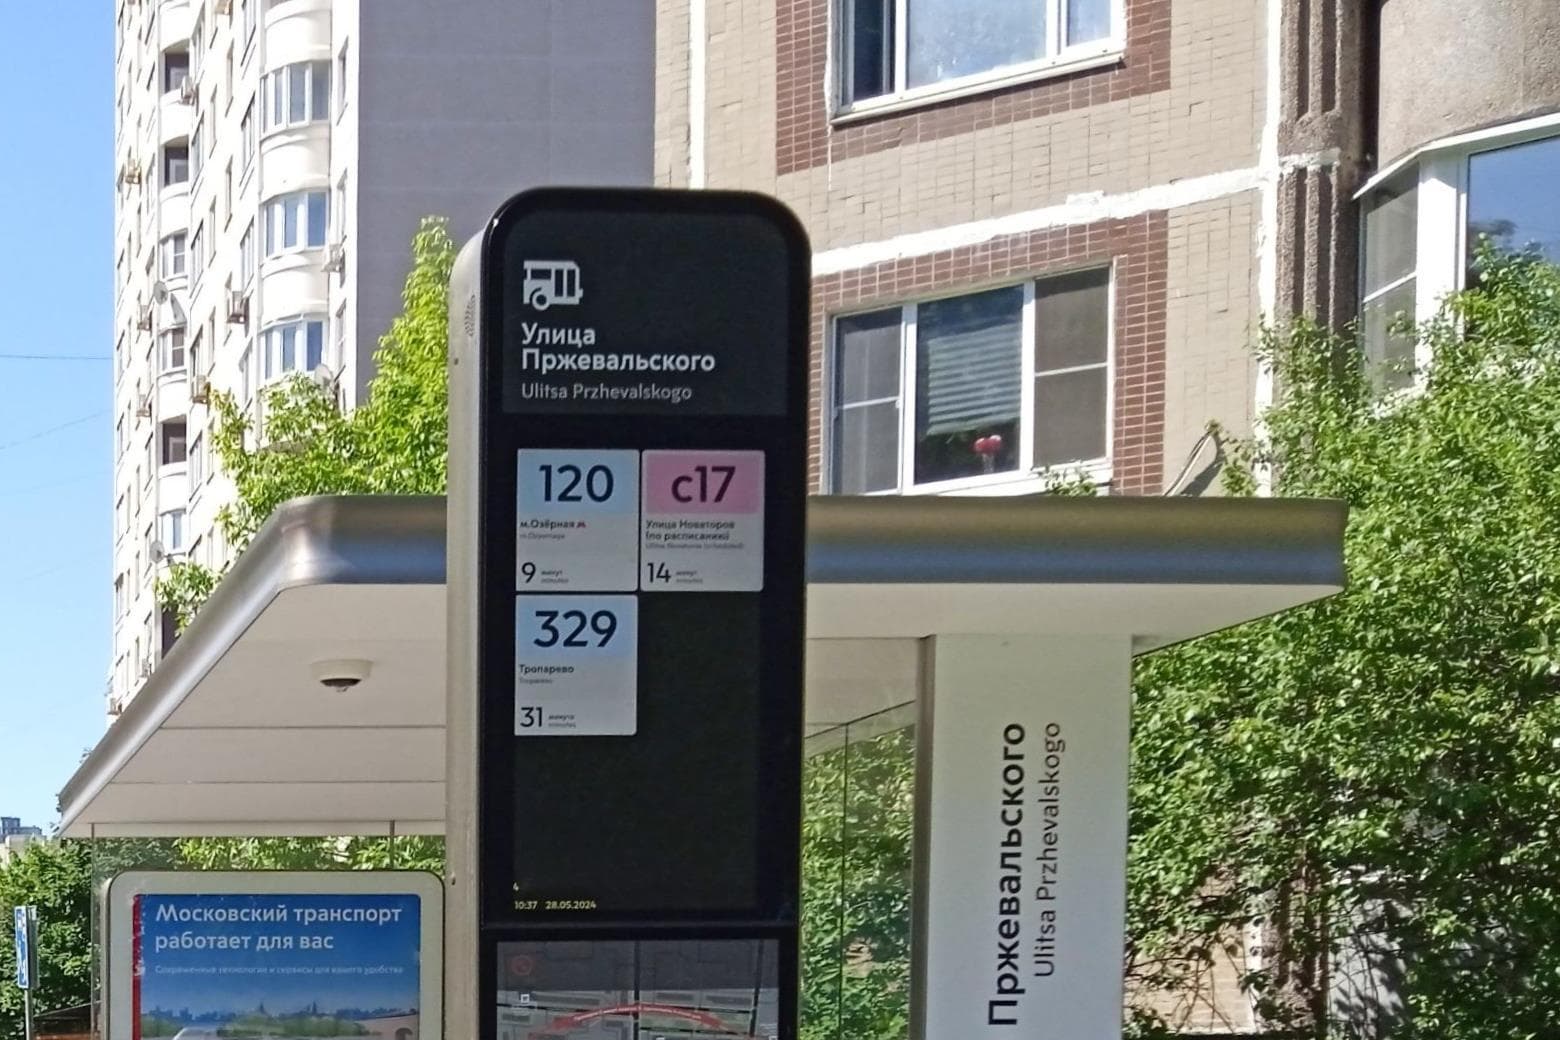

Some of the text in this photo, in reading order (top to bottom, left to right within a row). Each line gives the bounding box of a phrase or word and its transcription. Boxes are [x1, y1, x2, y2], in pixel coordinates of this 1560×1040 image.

[521, 322, 596, 348] Улица
[521, 348, 716, 375] Пржевальского
[521, 383, 692, 404] Ulitsa Przhevalskogo
[539, 464, 614, 502] 120
[671, 465, 736, 503] с17
[521, 562, 536, 584] 9
[647, 562, 672, 583] 14
[534, 610, 617, 648] 329
[519, 664, 575, 675] Тропарево
[520, 706, 543, 728] 31
[1034, 722, 1066, 977] Ulitsa Przhevalskogo
[988, 722, 1027, 1027] Пржевальского
[155, 904, 403, 925] Московский транспорт
[544, 900, 597, 910] 28.05.2024
[155, 932, 334, 952] работает для вас
